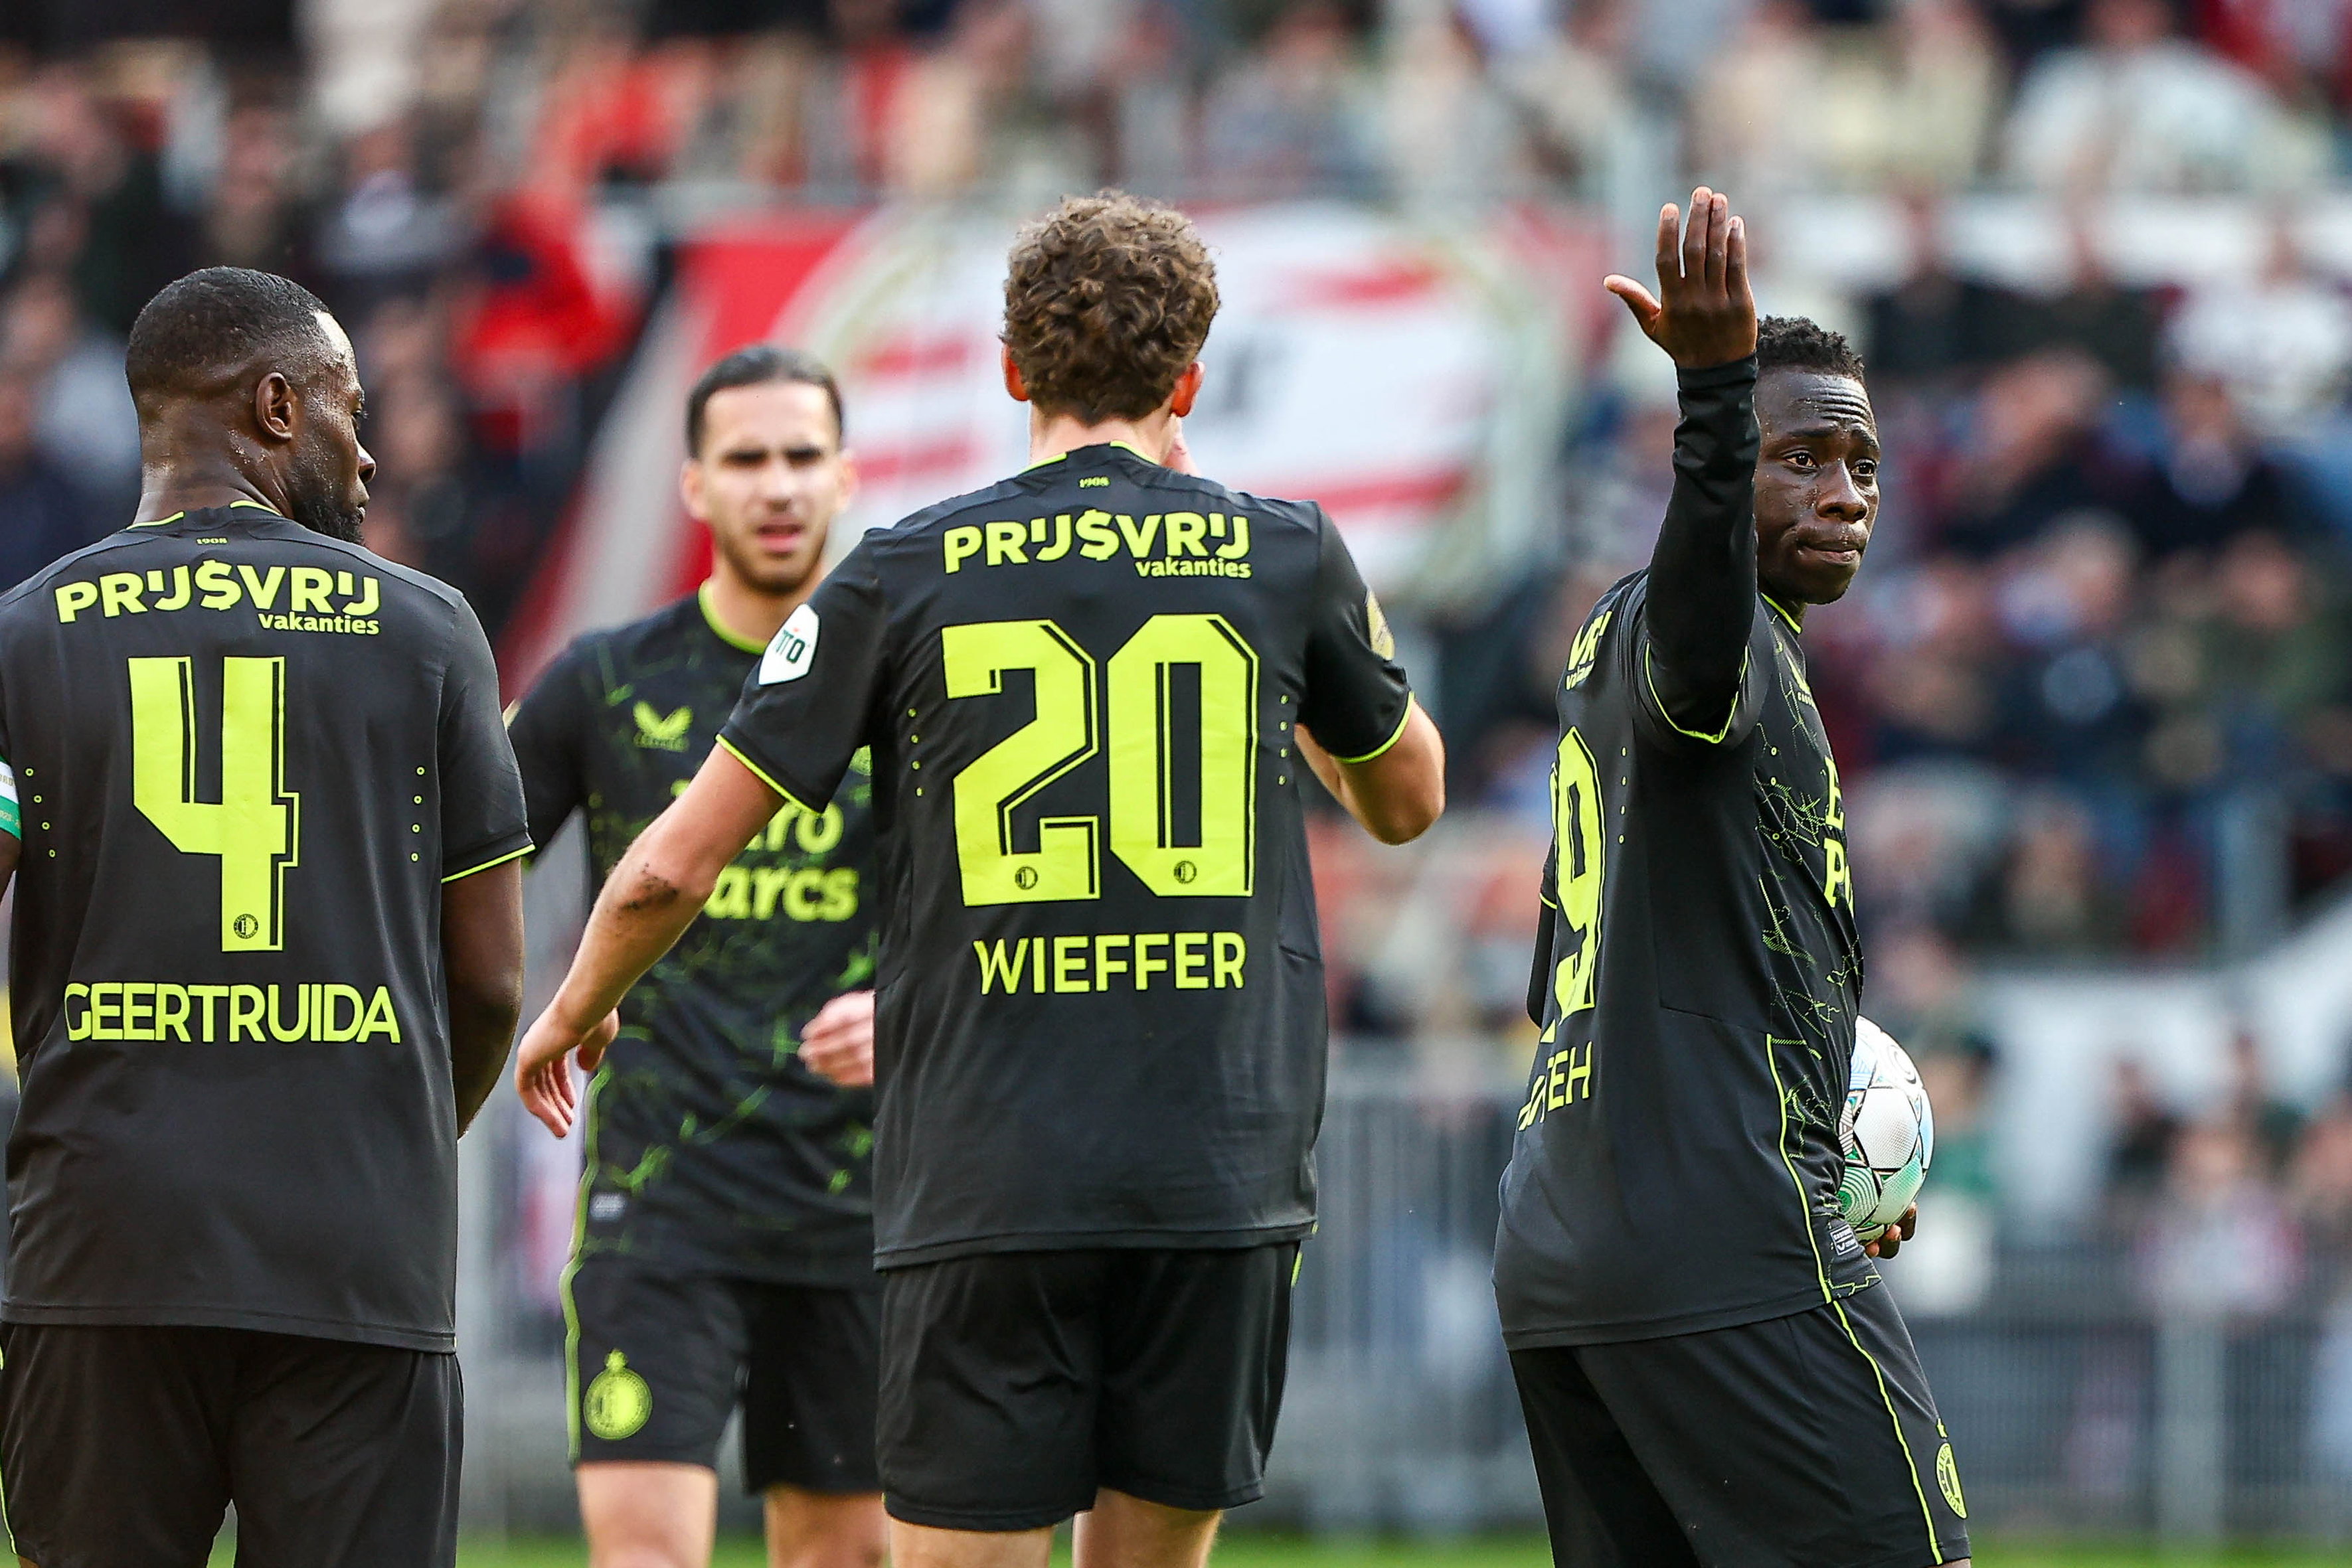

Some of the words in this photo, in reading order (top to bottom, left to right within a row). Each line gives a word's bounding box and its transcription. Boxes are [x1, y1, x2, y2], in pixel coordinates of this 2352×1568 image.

[1135, 556, 1252, 579] vakanties
[258, 611, 380, 635] vakanties
[941, 613, 1260, 907] 20
[127, 656, 299, 952] 4
[703, 866, 860, 921] arcs
[1547, 726, 1607, 1026] 9
[972, 932, 1247, 995] WIEFFER
[64, 982, 401, 1044] GEERTRUIDA
